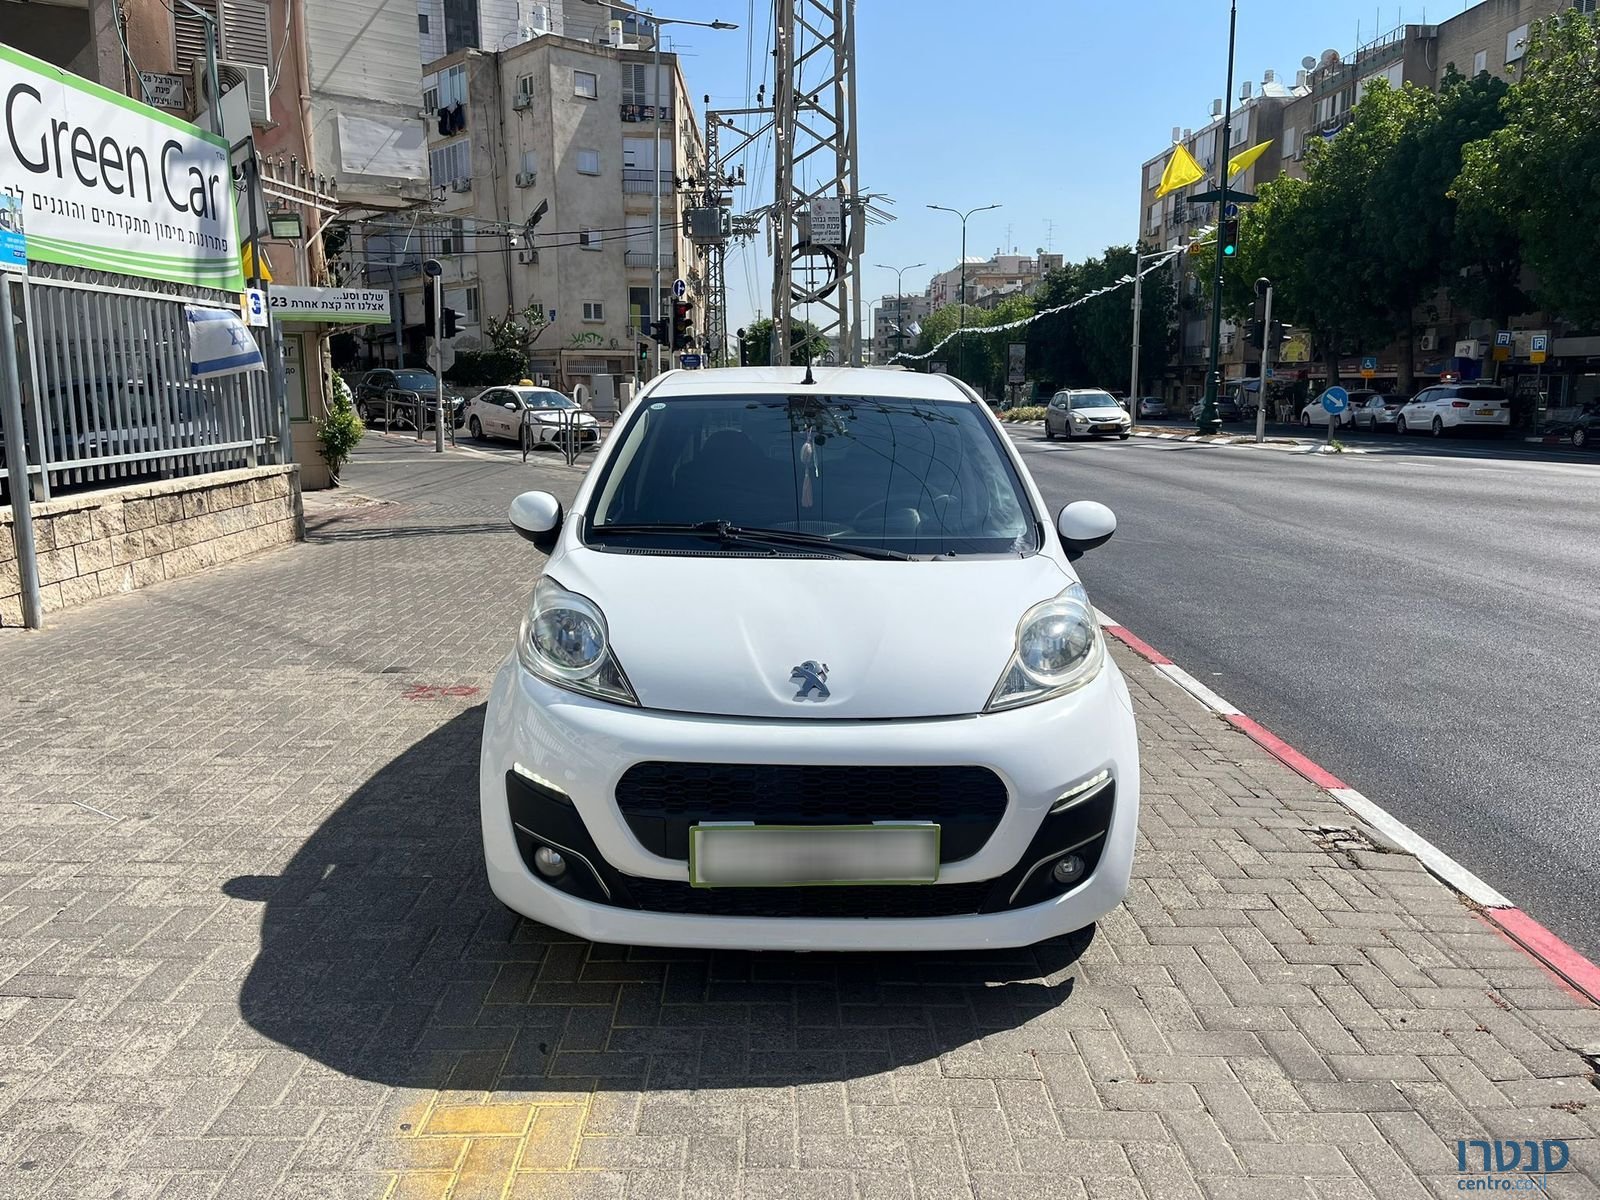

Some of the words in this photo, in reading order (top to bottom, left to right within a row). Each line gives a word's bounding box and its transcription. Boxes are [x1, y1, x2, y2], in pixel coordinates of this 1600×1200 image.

[153, 75, 172, 86] הרצל
[155, 86, 170, 94] פינת
[5, 83, 152, 203] Green
[161, 140, 219, 221] Car
[32, 193, 85, 220] והוגנים
[91, 207, 150, 235] מתקדמים
[155, 222, 185, 242] מימון
[188, 230, 228, 252] פתרונות
[271, 296, 287, 307] 23
[362, 291, 384, 301] שלם
[291, 300, 318, 308] אחרת
[321, 301, 341, 311] קצת
[345, 301, 356, 311] זה
[358, 301, 384, 311] אצלנו
